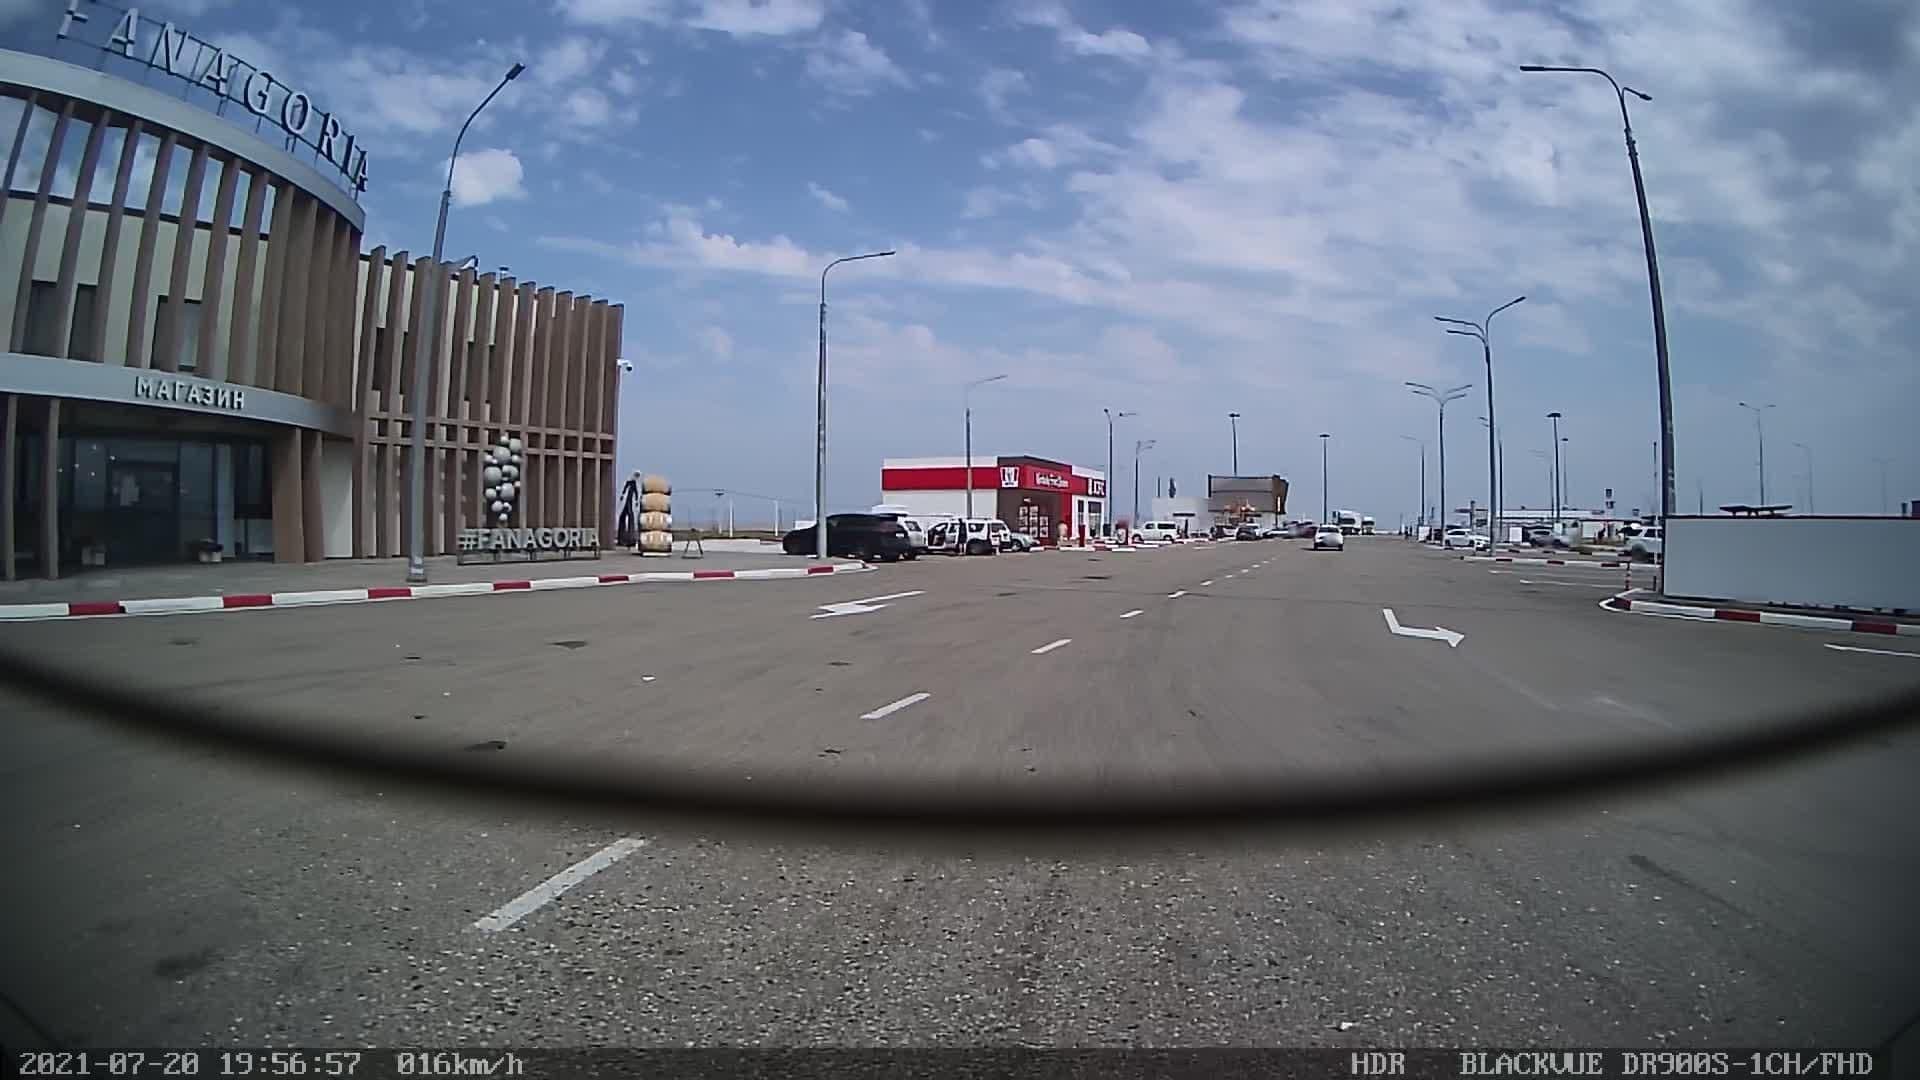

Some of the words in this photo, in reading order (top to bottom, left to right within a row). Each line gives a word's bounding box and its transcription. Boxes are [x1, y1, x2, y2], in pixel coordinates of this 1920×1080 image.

[56, 0, 368, 192] FANAGORIA
[136, 376, 245, 409] МАГАЗИН
[458, 528, 600, 550] #FANAGORIA
